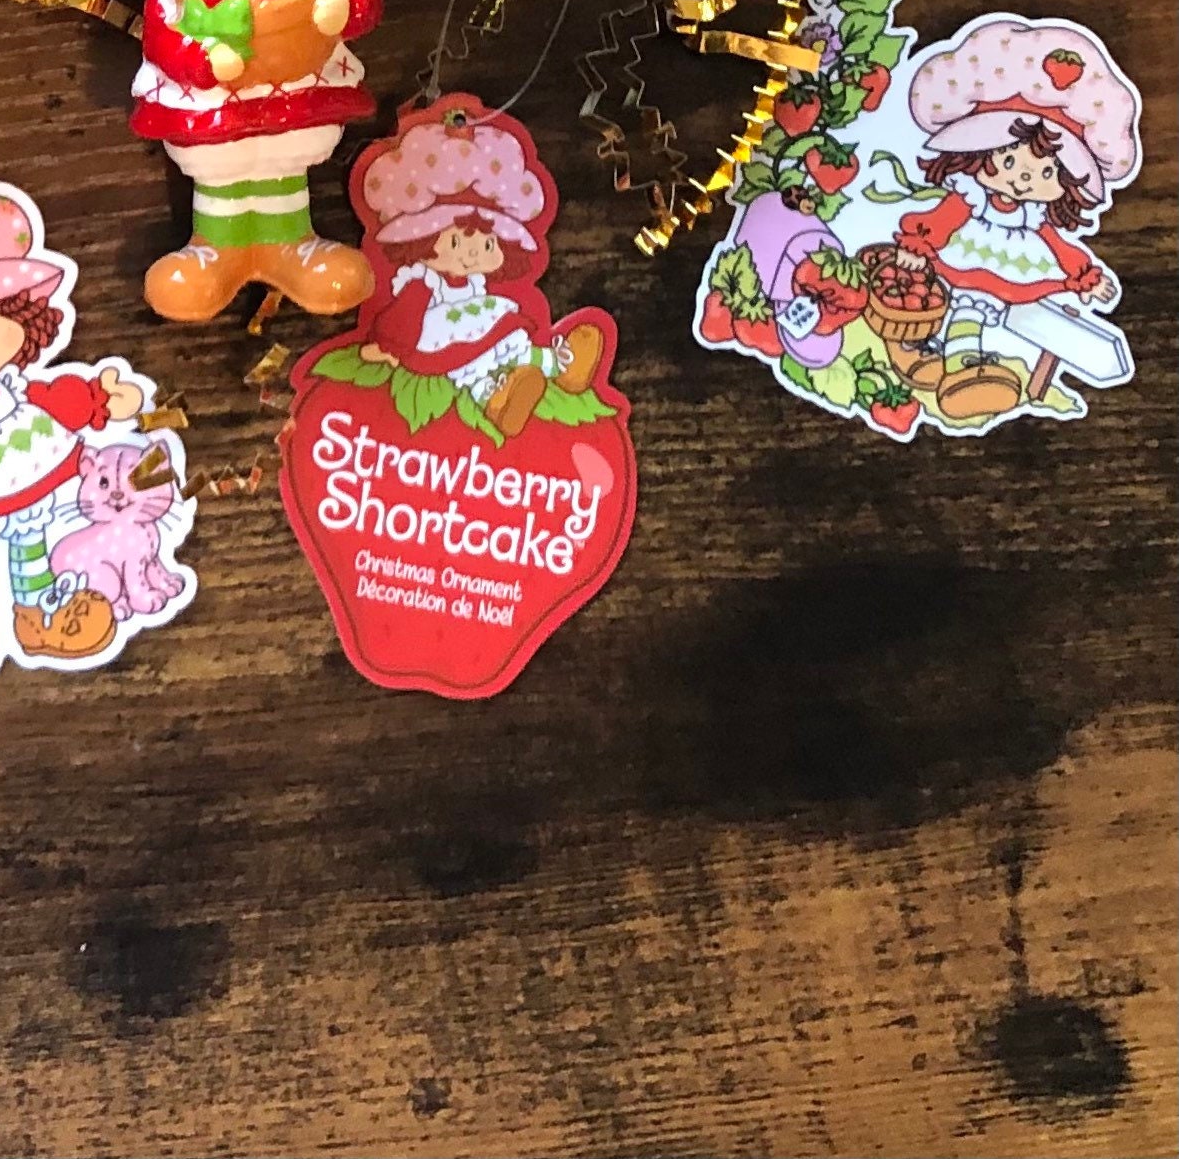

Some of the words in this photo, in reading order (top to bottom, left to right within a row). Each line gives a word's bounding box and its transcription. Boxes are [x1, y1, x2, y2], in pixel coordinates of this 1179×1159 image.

[312, 411, 602, 540] Strawberry
[317, 470, 574, 575] Shortcake
[355, 550, 436, 585] Christmas
[441, 566, 523, 602] Ornament
[356, 575, 447, 613] Décoration
[451, 594, 474, 619] de
[478, 599, 515, 627] Noël
